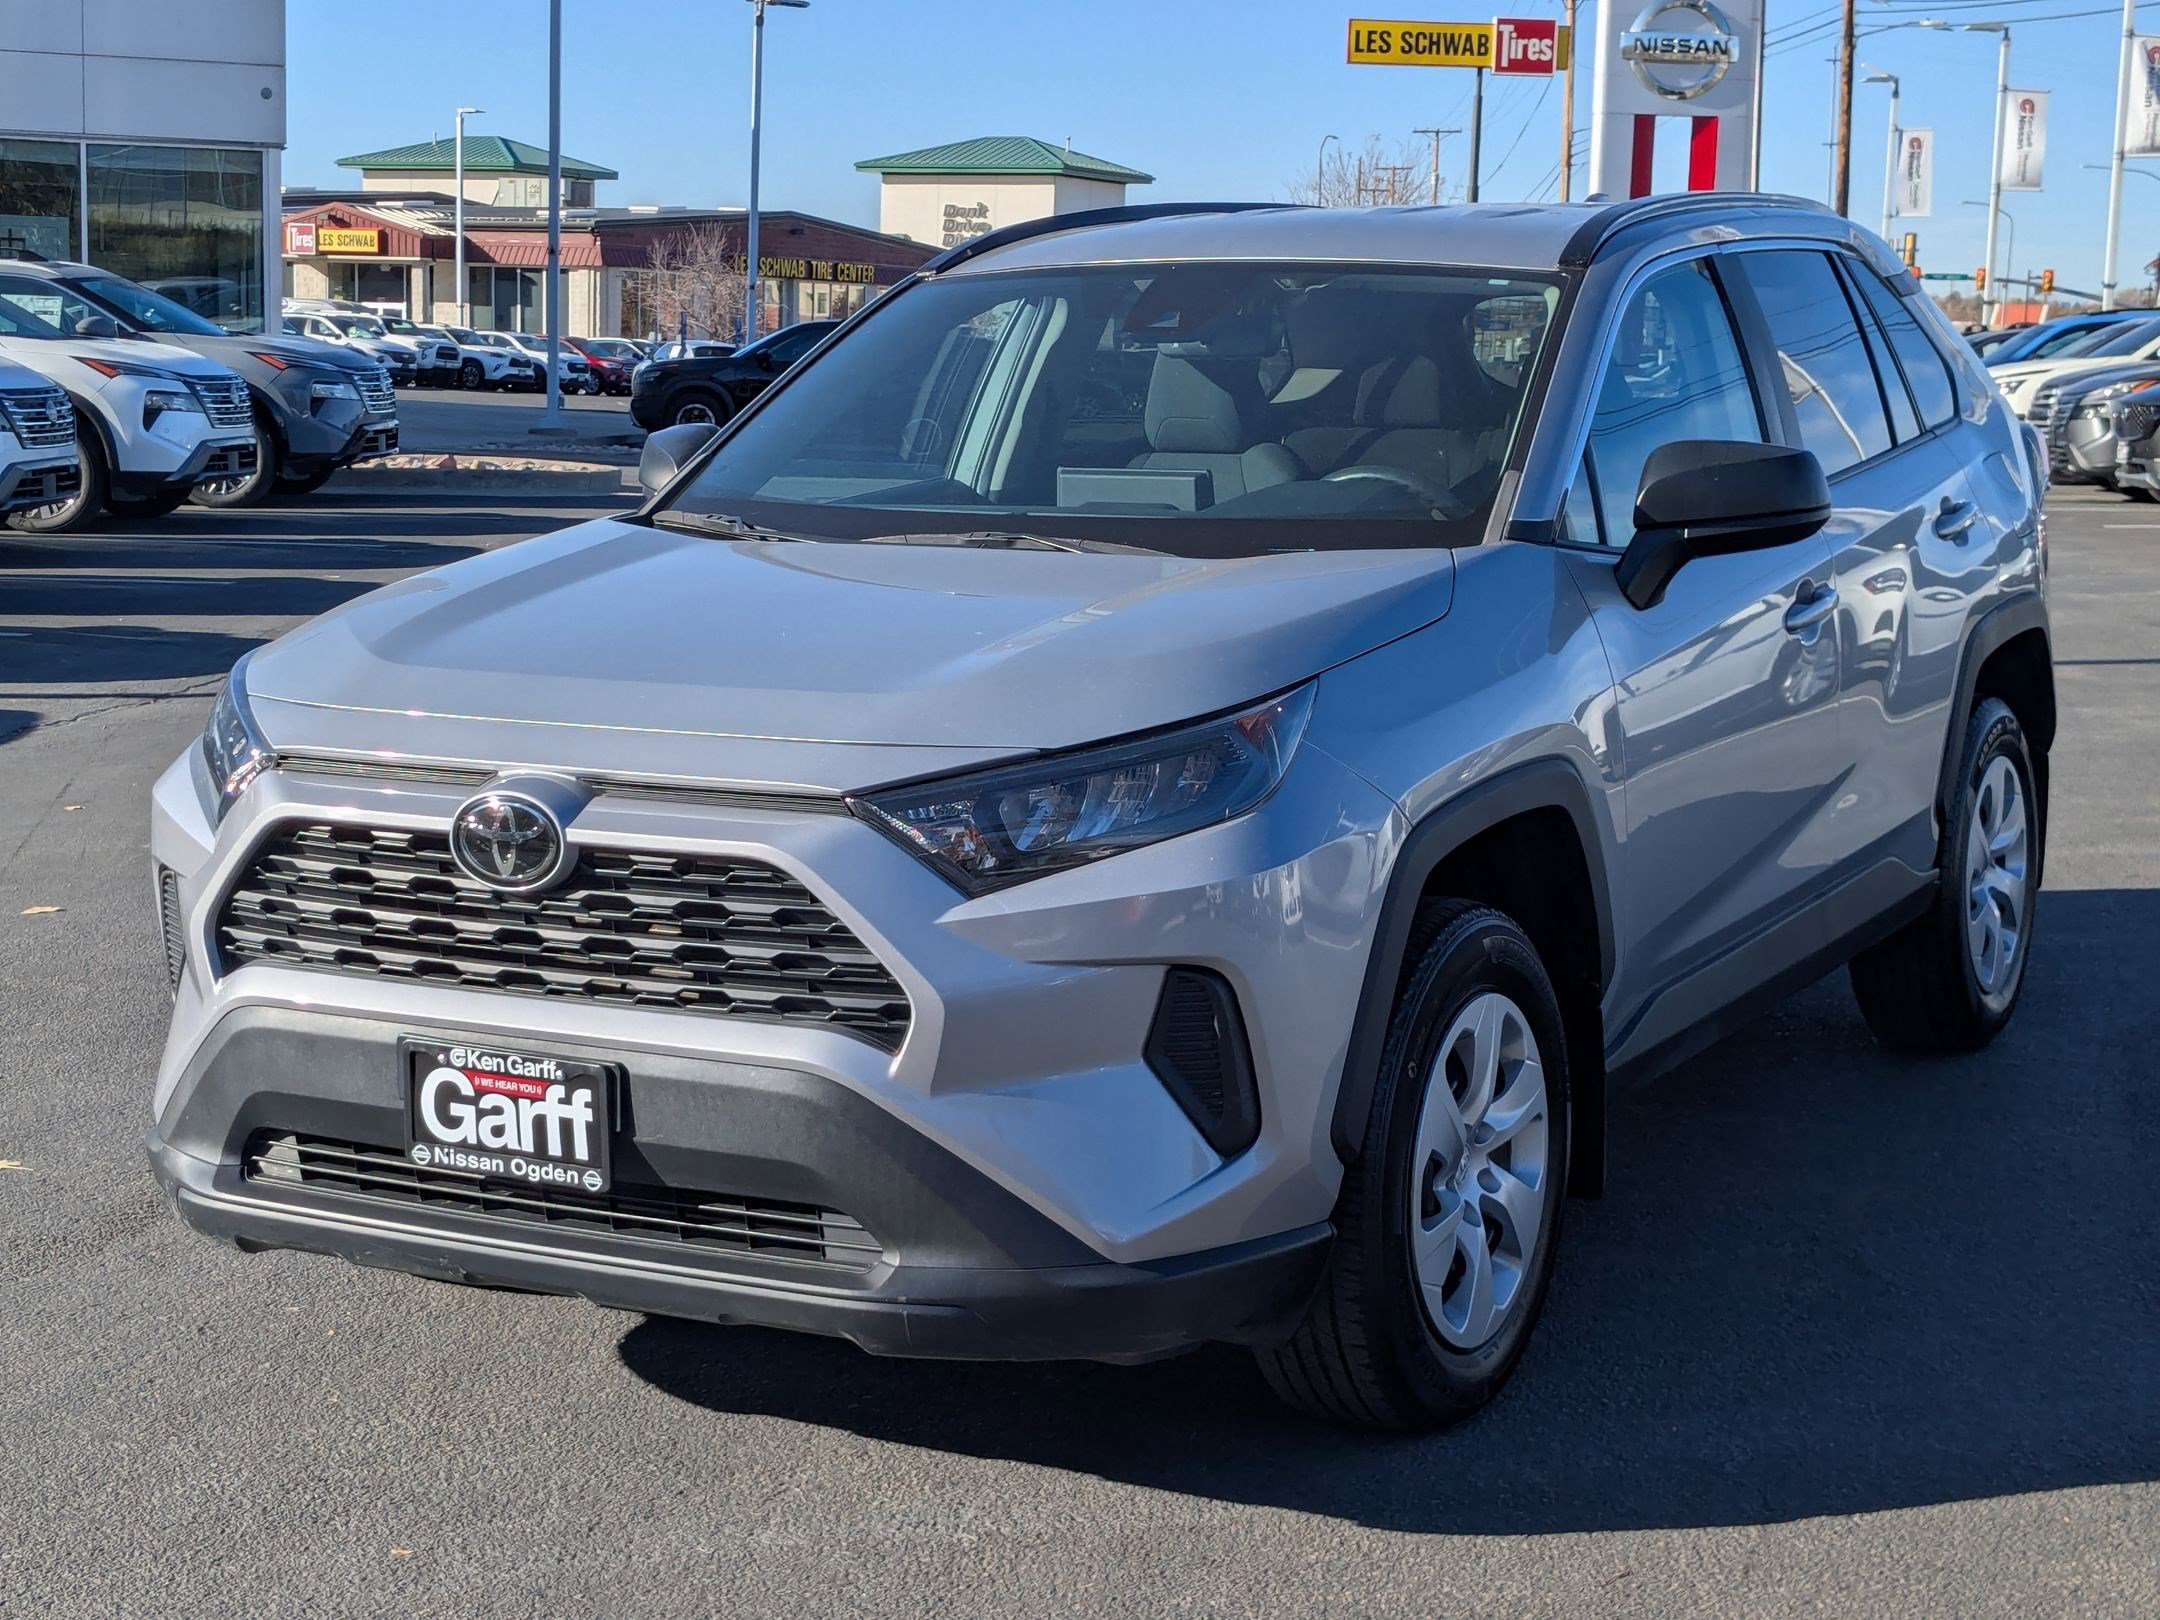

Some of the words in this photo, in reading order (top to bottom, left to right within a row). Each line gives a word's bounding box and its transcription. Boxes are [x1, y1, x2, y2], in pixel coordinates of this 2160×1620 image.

[1354, 30, 1392, 54] LES
[1400, 31, 1489, 57] SCHWAB
[1499, 24, 1553, 68] Tires
[1634, 37, 1729, 55] NISSAN
[291, 227, 313, 251] Tires
[319, 233, 333, 246] LES
[337, 234, 375, 248] SCHWAB
[734, 255, 748, 275] LE
[759, 256, 806, 278] SCHWAB
[811, 260, 834, 281] TIRE
[837, 262, 876, 284] CENTER
[467, 1051, 505, 1074] Ken
[507, 1055, 557, 1081] Garff
[480, 1077, 494, 1088] WE
[495, 1080, 518, 1092] HEAR
[519, 1082, 537, 1094] YOU
[421, 1067, 593, 1162] Garff
[434, 1147, 504, 1173] Nissan
[510, 1158, 579, 1185] Ogden
